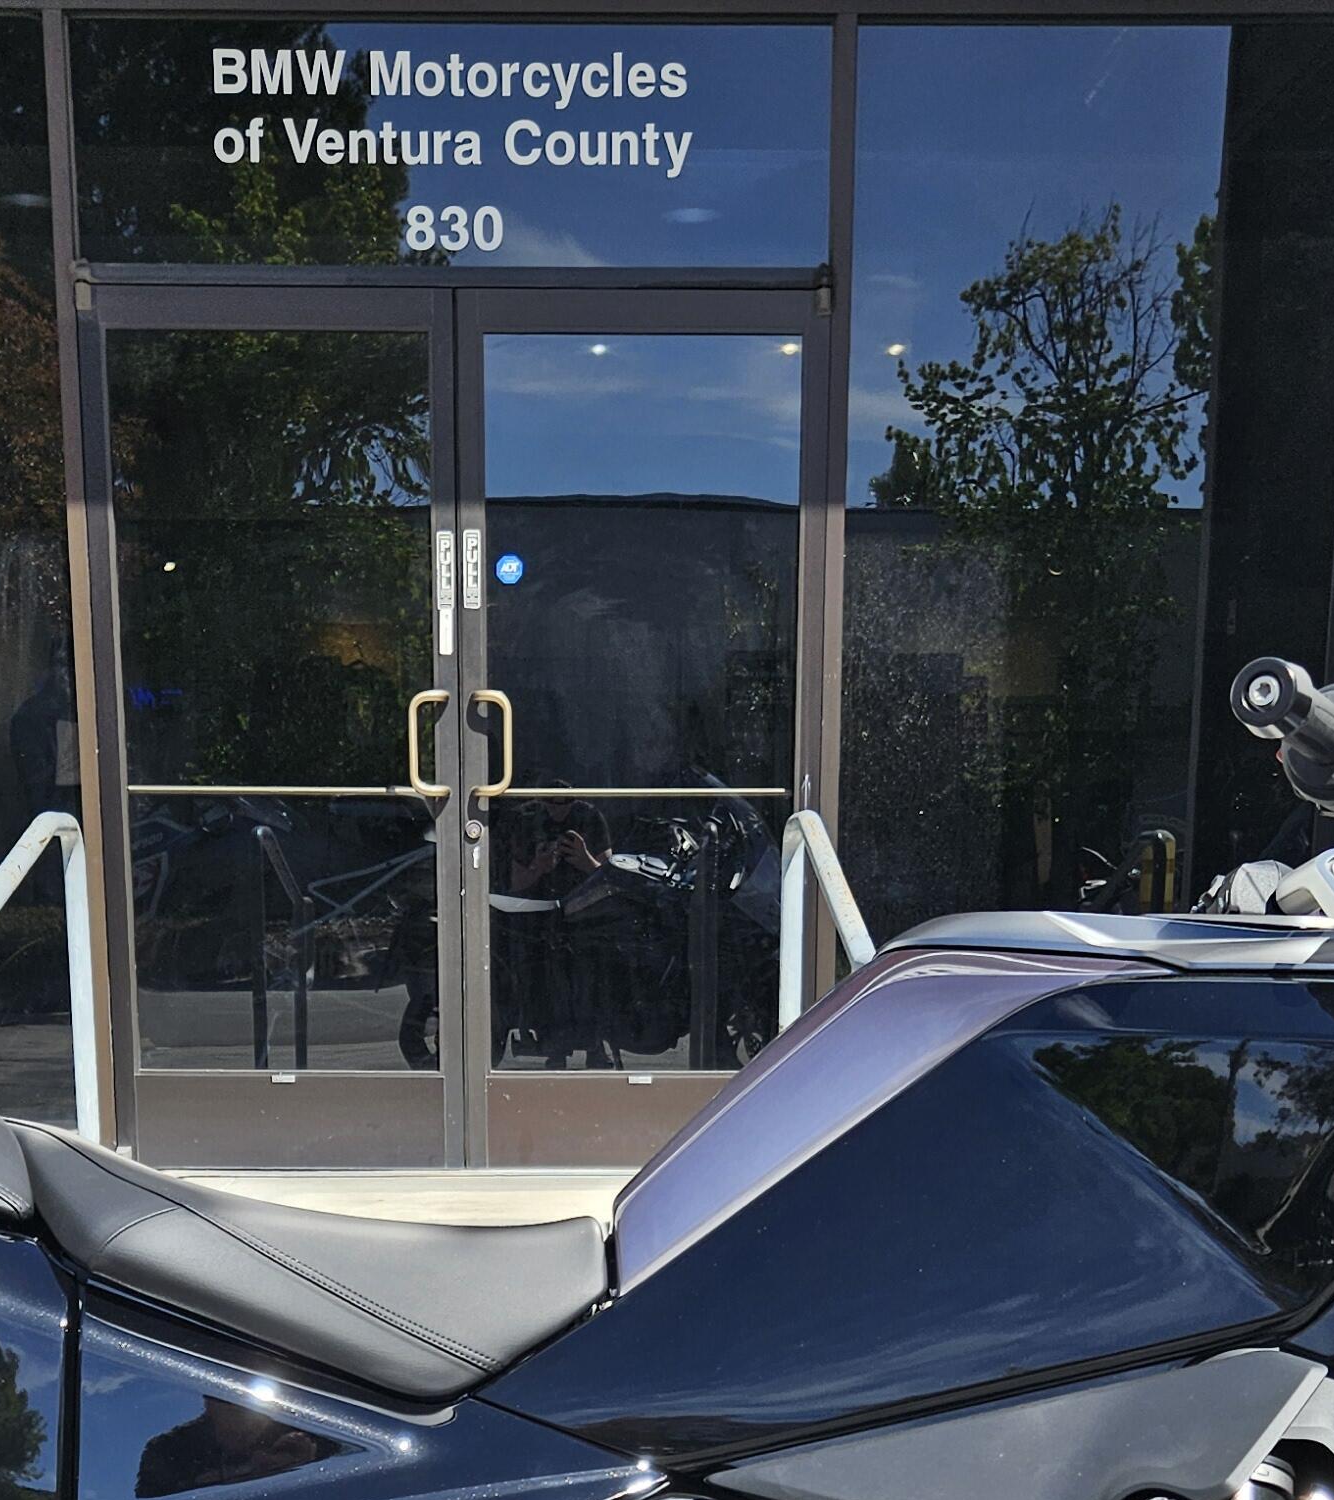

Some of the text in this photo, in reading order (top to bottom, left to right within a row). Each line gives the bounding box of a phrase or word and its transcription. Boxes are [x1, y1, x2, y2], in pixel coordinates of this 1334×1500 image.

[212, 48, 688, 109] BMW Motorcycles
[213, 117, 693, 178] of Ventura County
[405, 204, 504, 252] 830
[440, 539, 451, 590] PULL
[466, 537, 478, 588] PULL
[500, 562, 519, 572] ADT
